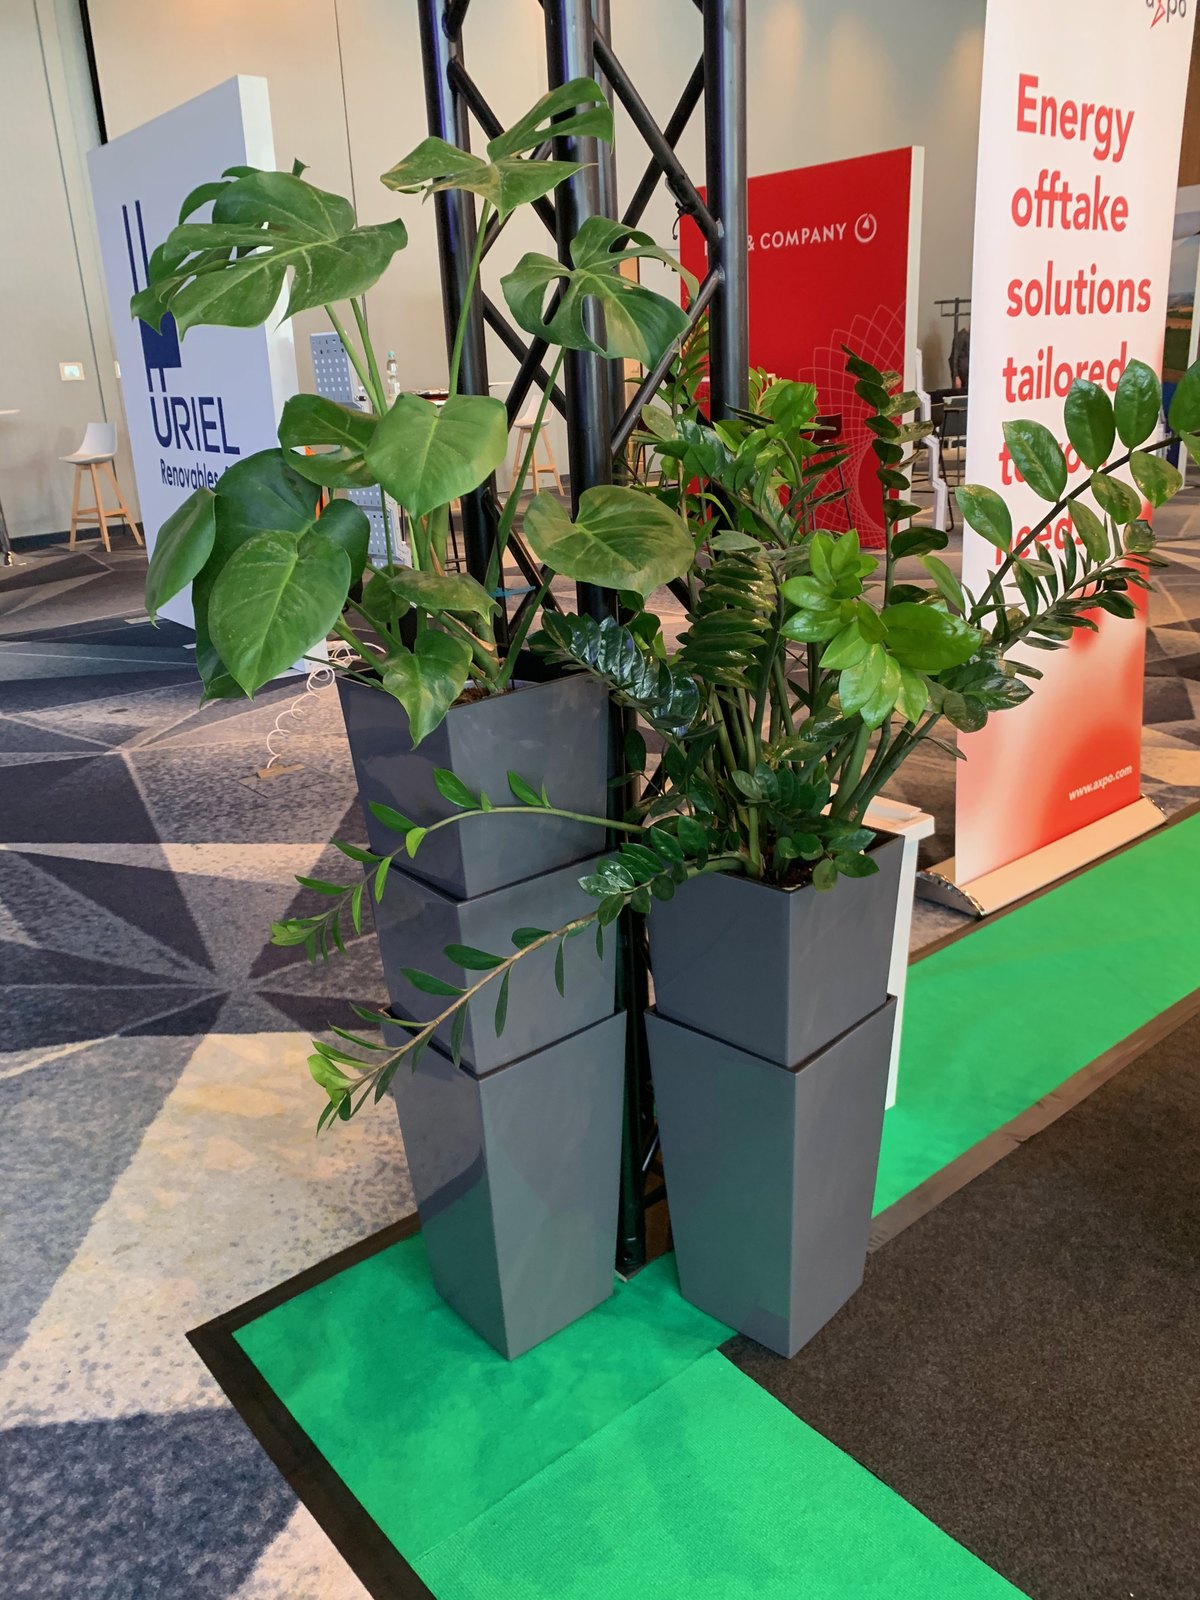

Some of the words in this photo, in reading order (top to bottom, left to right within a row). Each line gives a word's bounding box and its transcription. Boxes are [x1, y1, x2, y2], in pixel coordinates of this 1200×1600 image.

[1016, 73, 1135, 163] Energy
[1011, 168, 1129, 232] offtake
[760, 222, 847, 250] COMPANY
[1006, 260, 1152, 317] solutions
[1002, 340, 1128, 403] tailored
[149, 396, 240, 455] URIEL
[160, 458, 219, 490] Renovables
[1068, 765, 1133, 801] www.axpo.com
